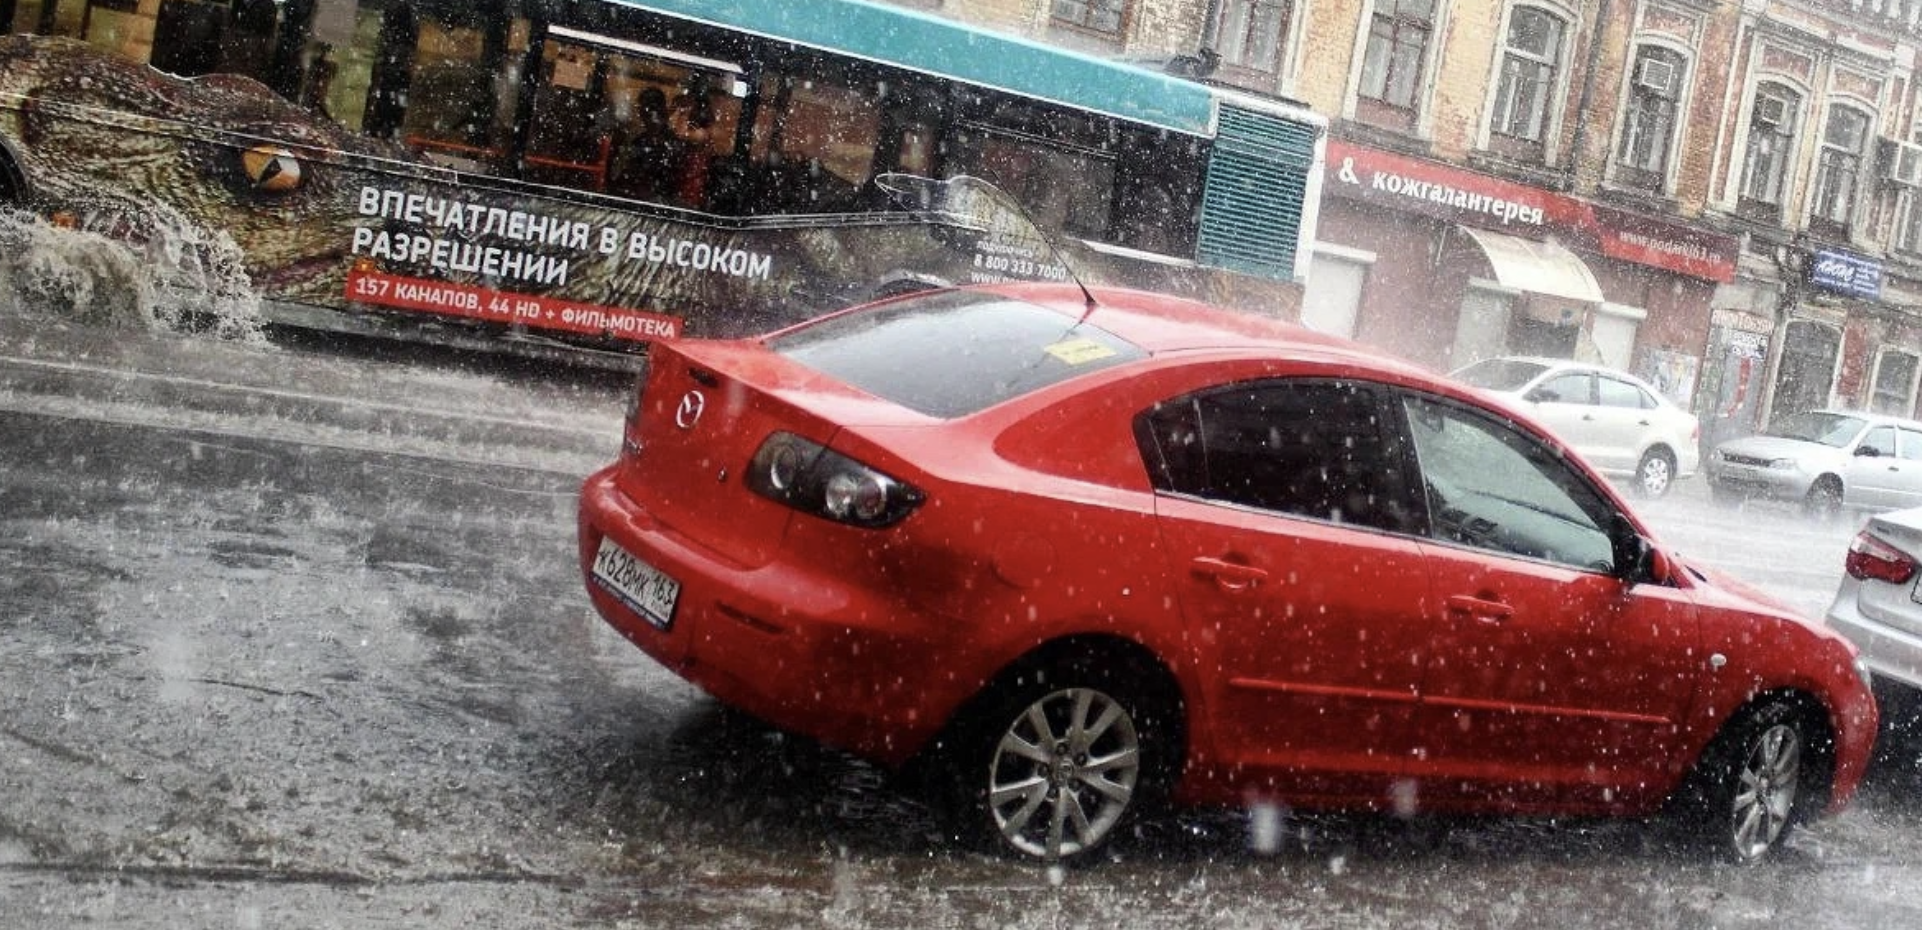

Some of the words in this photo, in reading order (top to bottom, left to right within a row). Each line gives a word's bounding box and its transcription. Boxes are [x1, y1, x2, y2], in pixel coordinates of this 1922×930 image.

[1339, 157, 1359, 185] &
[1372, 171, 1544, 225] кожгалантерея
[352, 228, 569, 287] РАЗРЕШЕНИИ
[358, 186, 588, 250] ВПЕЧАТЛЕНИЯ
[599, 229, 617, 254] В
[628, 235, 771, 281] ВЫСОКОМ
[974, 254, 982, 267] 8
[985, 255, 1008, 271] 800
[1011, 260, 1033, 275] 333
[1037, 264, 1066, 280] 7000
[356, 278, 389, 295] 157
[394, 283, 483, 314] КАНАЛОВ,
[489, 296, 510, 315] 44
[515, 301, 541, 319] HD
[546, 312, 555, 320] +
[562, 309, 676, 337] ФИЛЬМОТЕКА
[654, 574, 676, 606] 163
